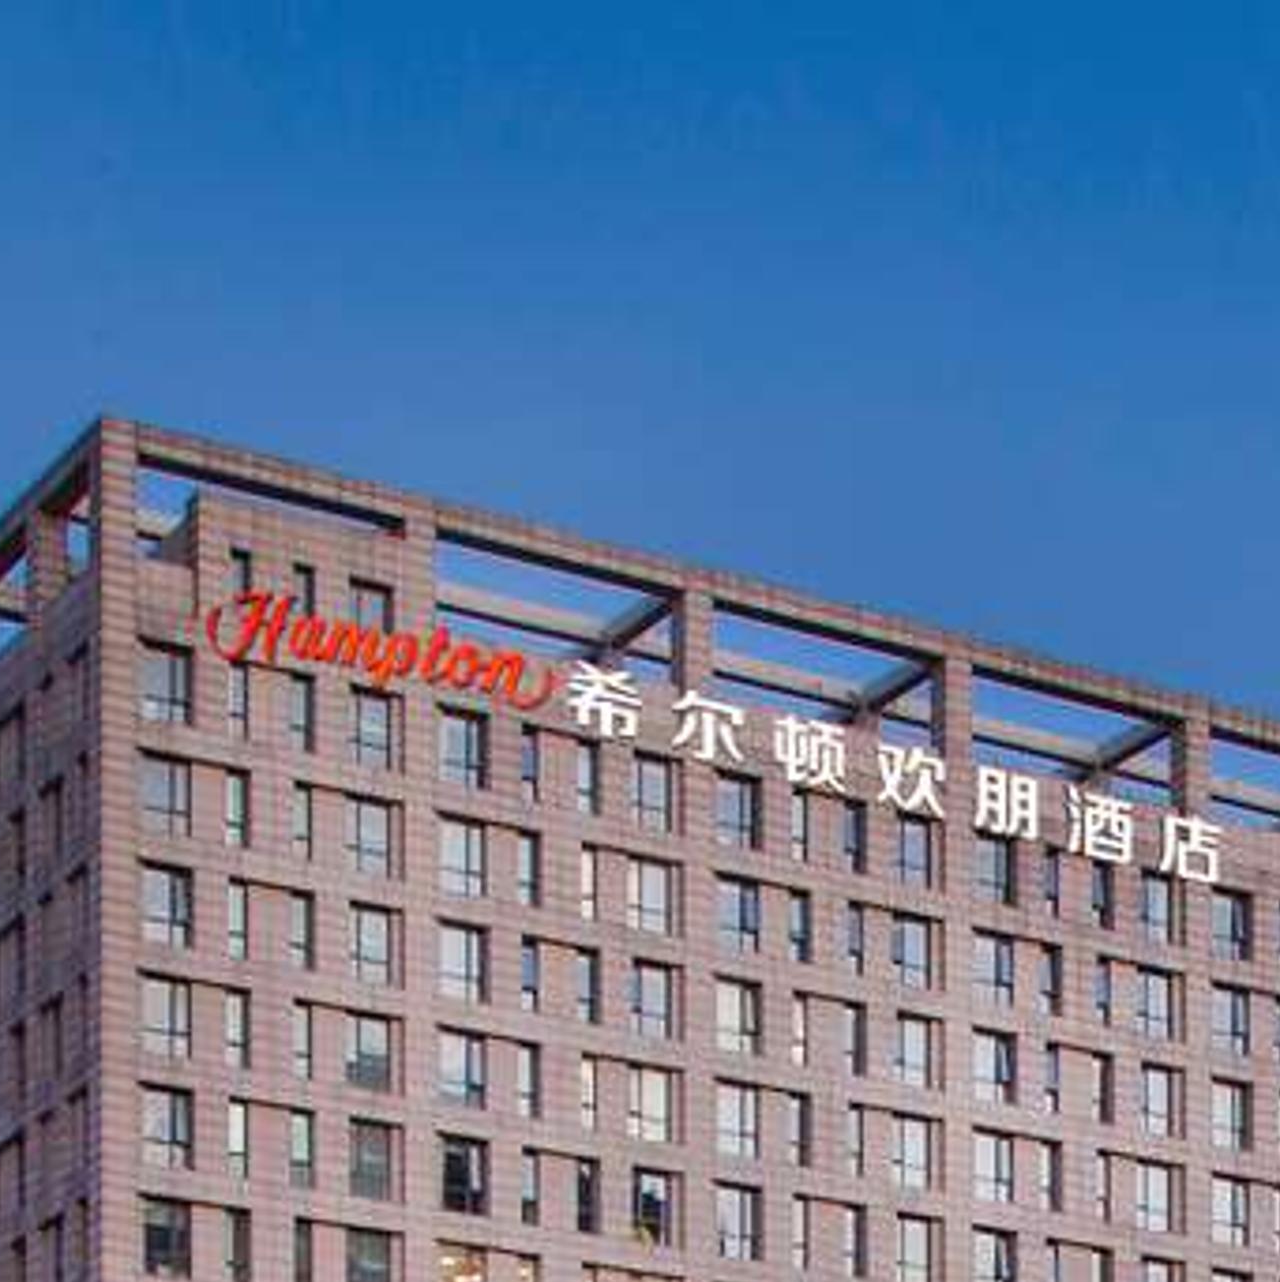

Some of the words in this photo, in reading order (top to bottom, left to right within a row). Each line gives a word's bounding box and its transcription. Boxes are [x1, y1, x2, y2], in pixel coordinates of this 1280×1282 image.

[206, 584, 554, 710] Hampton
[568, 661, 1221, 882] 希尔顿欢朋酒店
